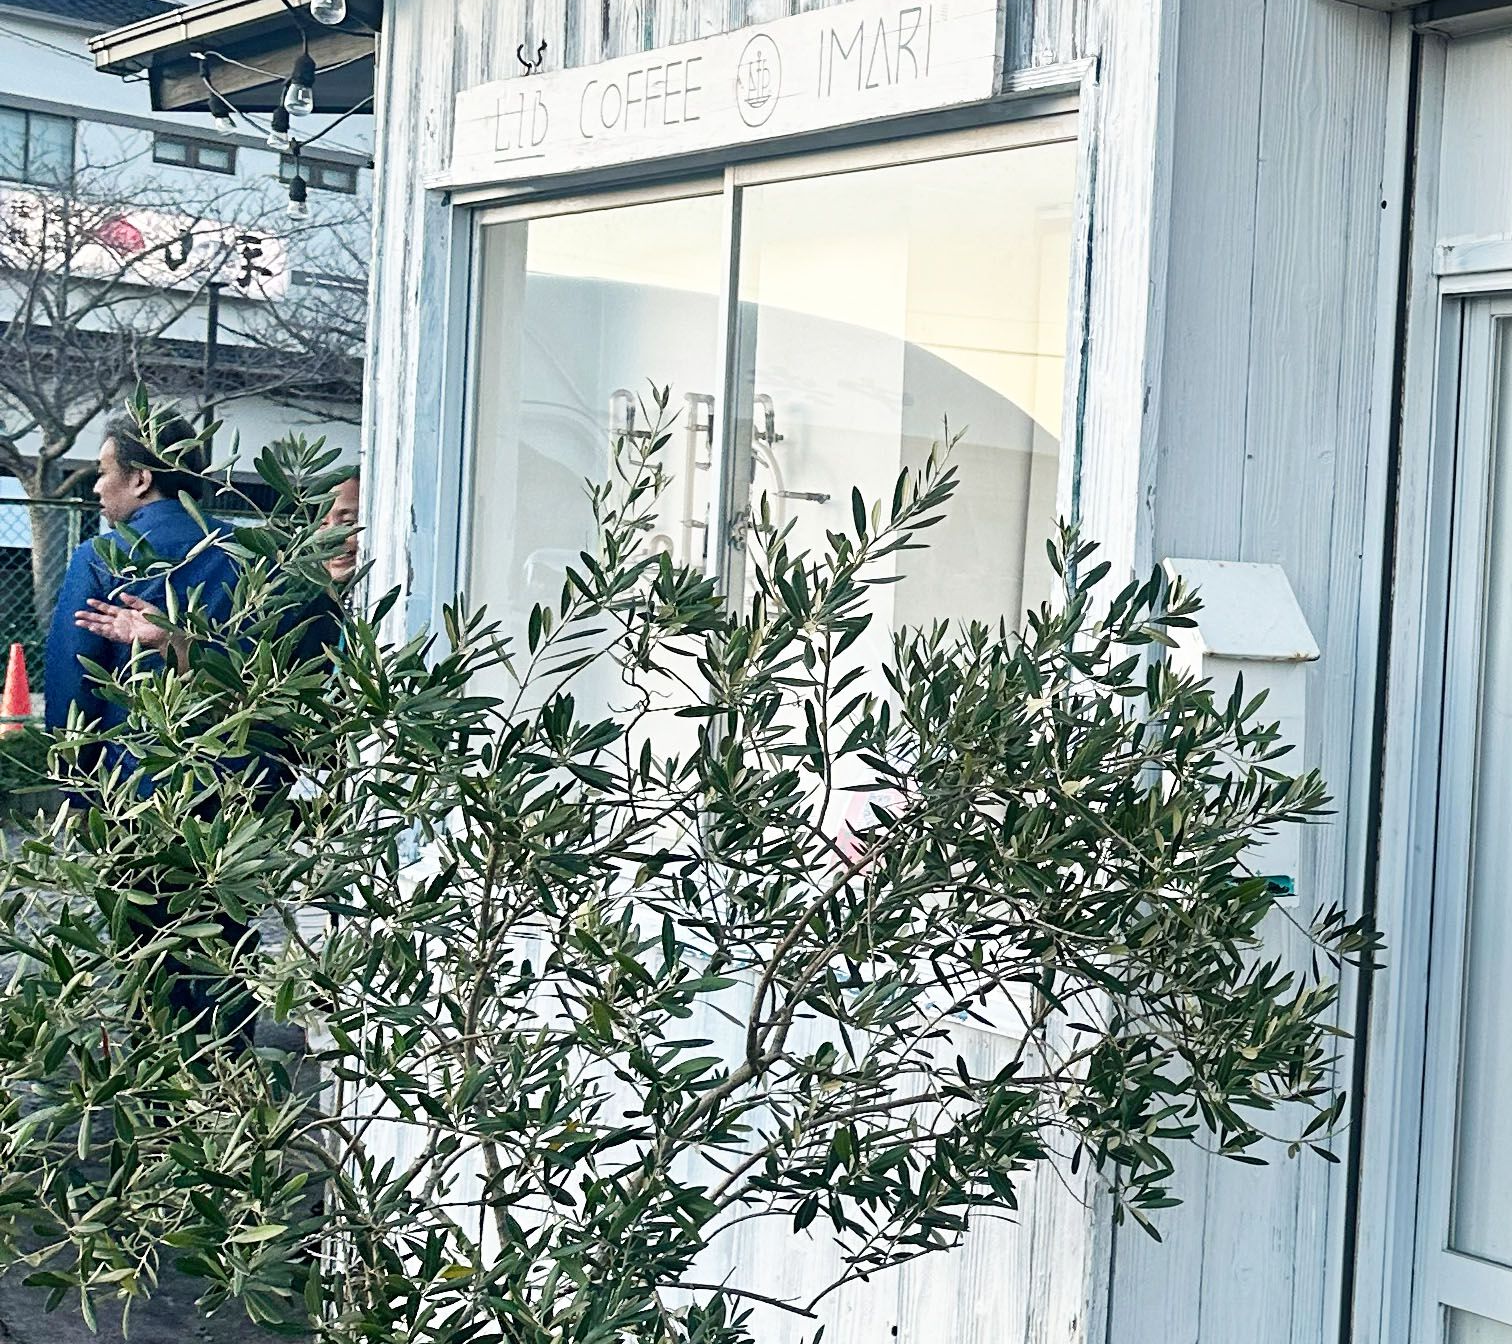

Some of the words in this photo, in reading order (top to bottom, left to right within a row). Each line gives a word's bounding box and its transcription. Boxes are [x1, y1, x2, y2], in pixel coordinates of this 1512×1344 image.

[494, 90, 549, 153] LIB
[579, 56, 703, 139] COFFEE
[817, 4, 933, 99] IMARI
